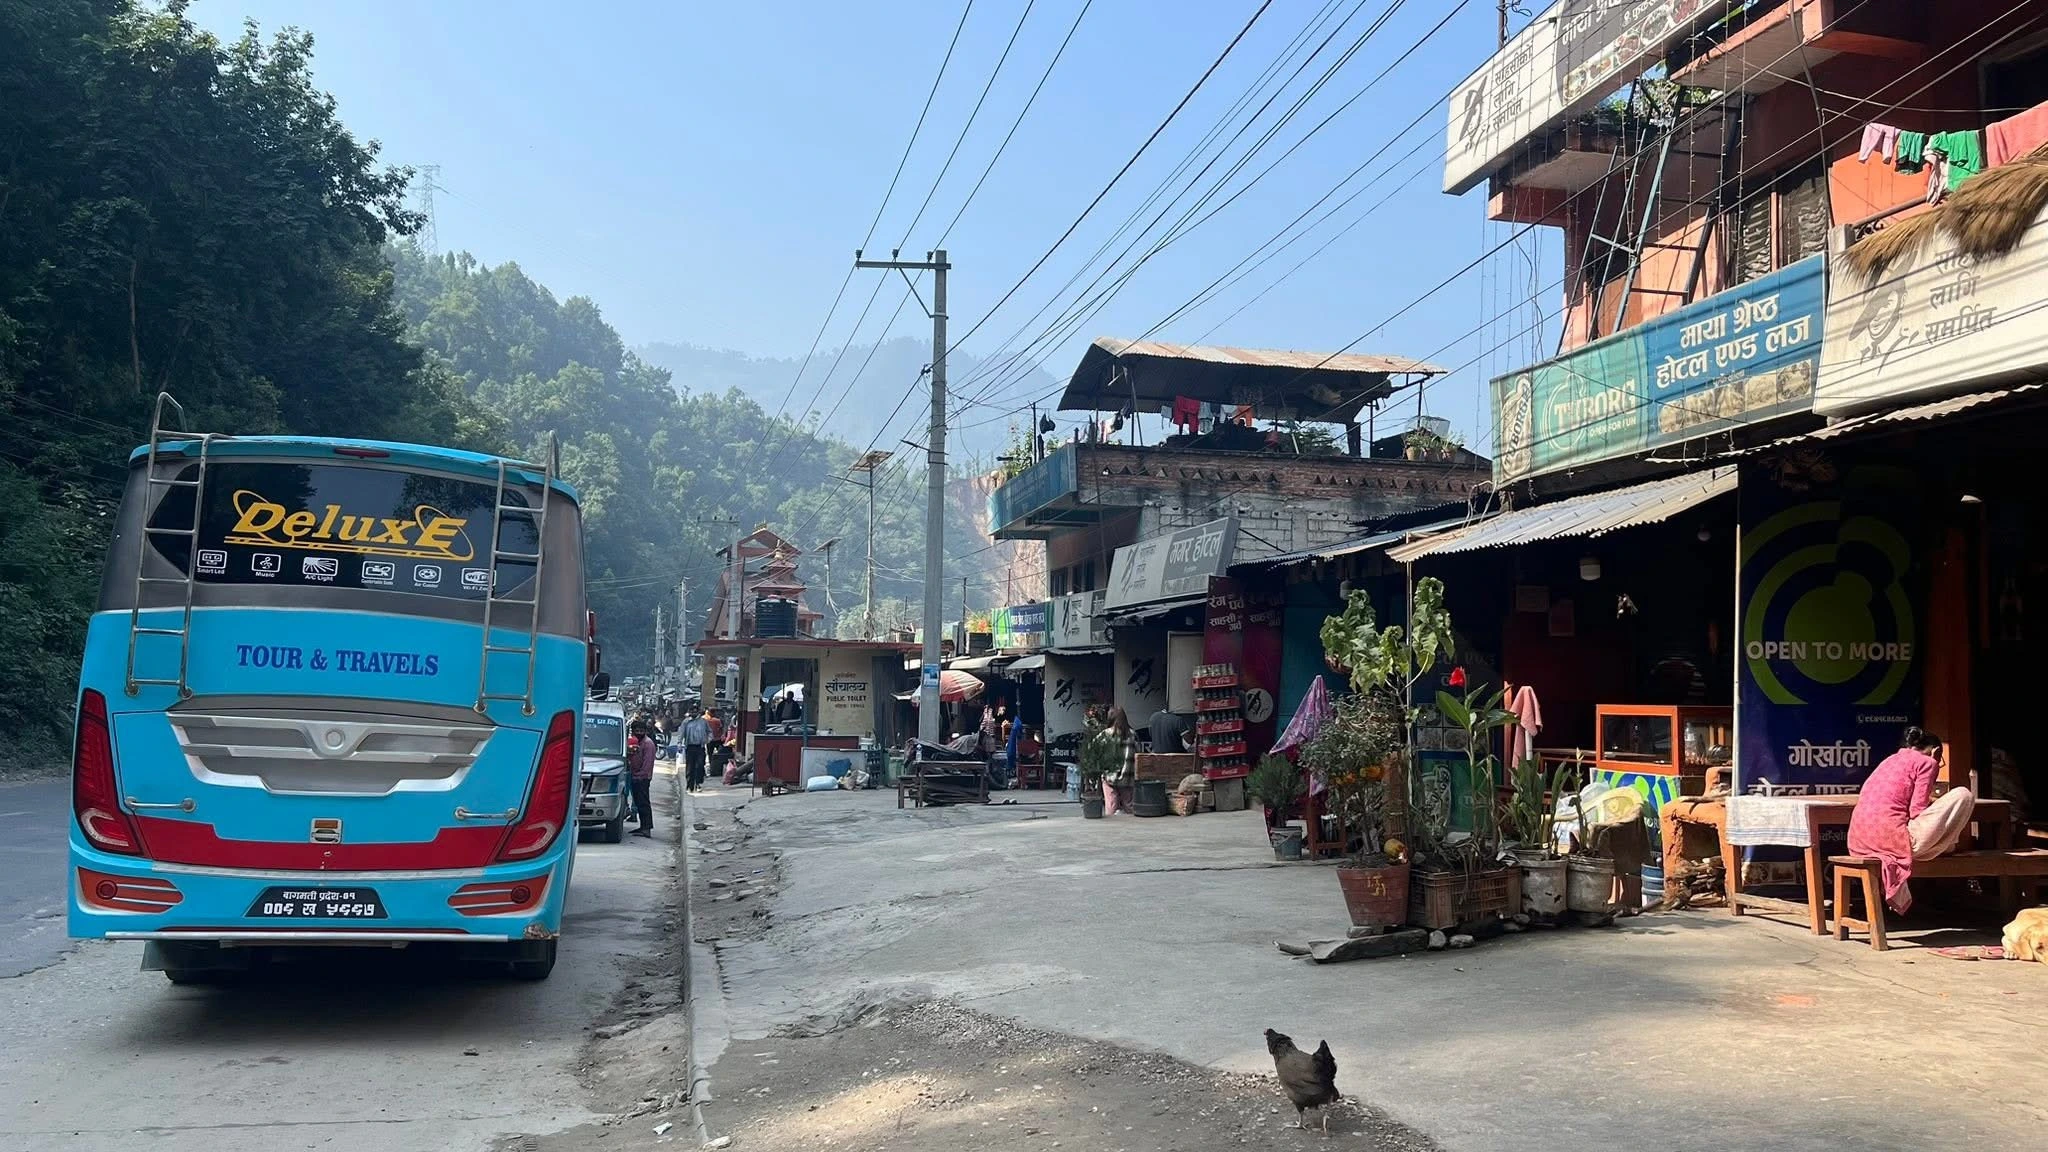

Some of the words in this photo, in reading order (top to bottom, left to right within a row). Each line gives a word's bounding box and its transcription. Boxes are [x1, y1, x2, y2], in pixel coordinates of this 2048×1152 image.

[1493, 80, 1515, 108] लागि
[1930, 271, 1981, 309] लागि
[1680, 313, 1727, 349] माया
[1733, 294, 1780, 333] श्रेष्ठ
[1925, 304, 1997, 344] समर्पित
[1656, 349, 1710, 389] होटल
[1714, 333, 1759, 368] एण्ड
[1765, 315, 1811, 353] लज
[1553, 379, 1636, 432] TUBORG
[1192, 527, 1224, 562] होटल
[237, 644, 303, 670] TOUR
[309, 648, 328, 671] &
[335, 650, 439, 676] TRAVELS
[1746, 640, 1806, 661] OPEN
[1812, 642, 1843, 661] TO
[1850, 642, 1912, 662] MORE
[1788, 738, 1871, 769] गोर्खाली
[282, 891, 316, 901] बागमती
[302, 903, 317, 916] ख
